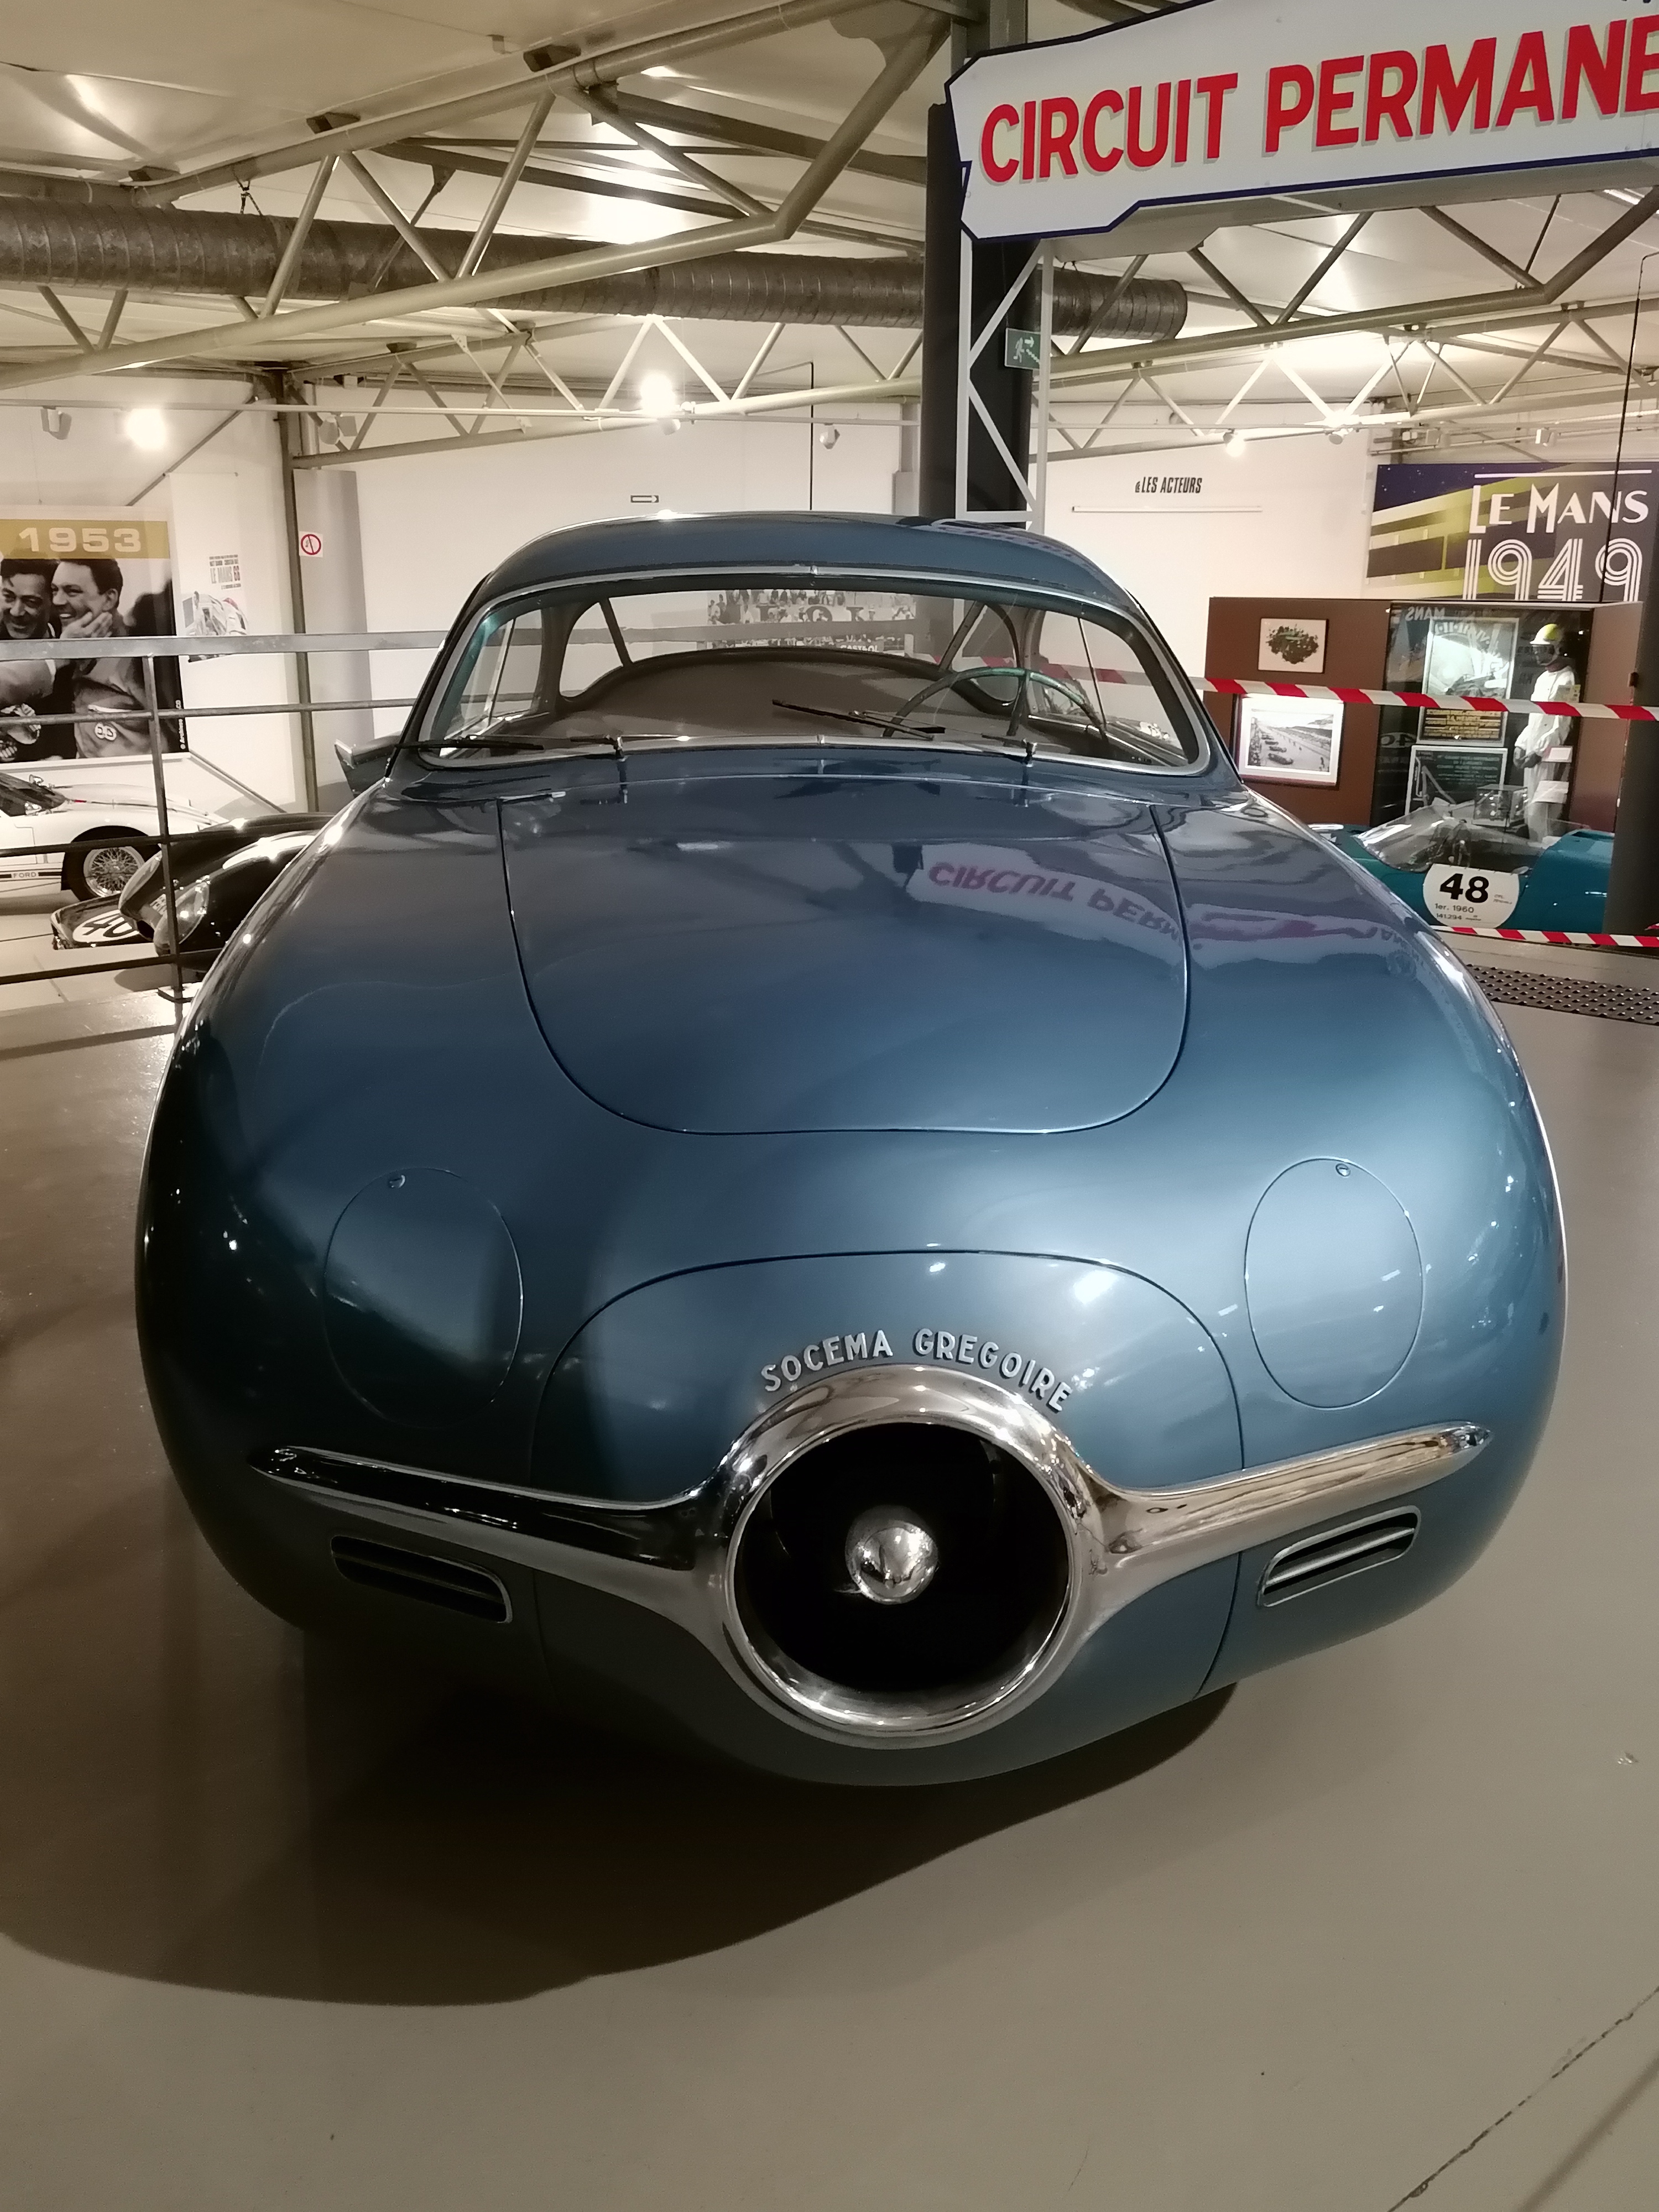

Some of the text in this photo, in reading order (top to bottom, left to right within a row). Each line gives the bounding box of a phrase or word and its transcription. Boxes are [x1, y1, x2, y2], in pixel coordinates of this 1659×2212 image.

[980, 14, 1659, 183] CIRCUIT PERMANE
[1160, 477, 1203, 493] ACTEURS
[19, 527, 141, 552] 1953
[1462, 538, 1643, 602] 1949
[1439, 873, 1489, 903] 48
[1453, 905, 1474, 913] 1960
[761, 1328, 1072, 1412] SOCEMA GREGOIRE
